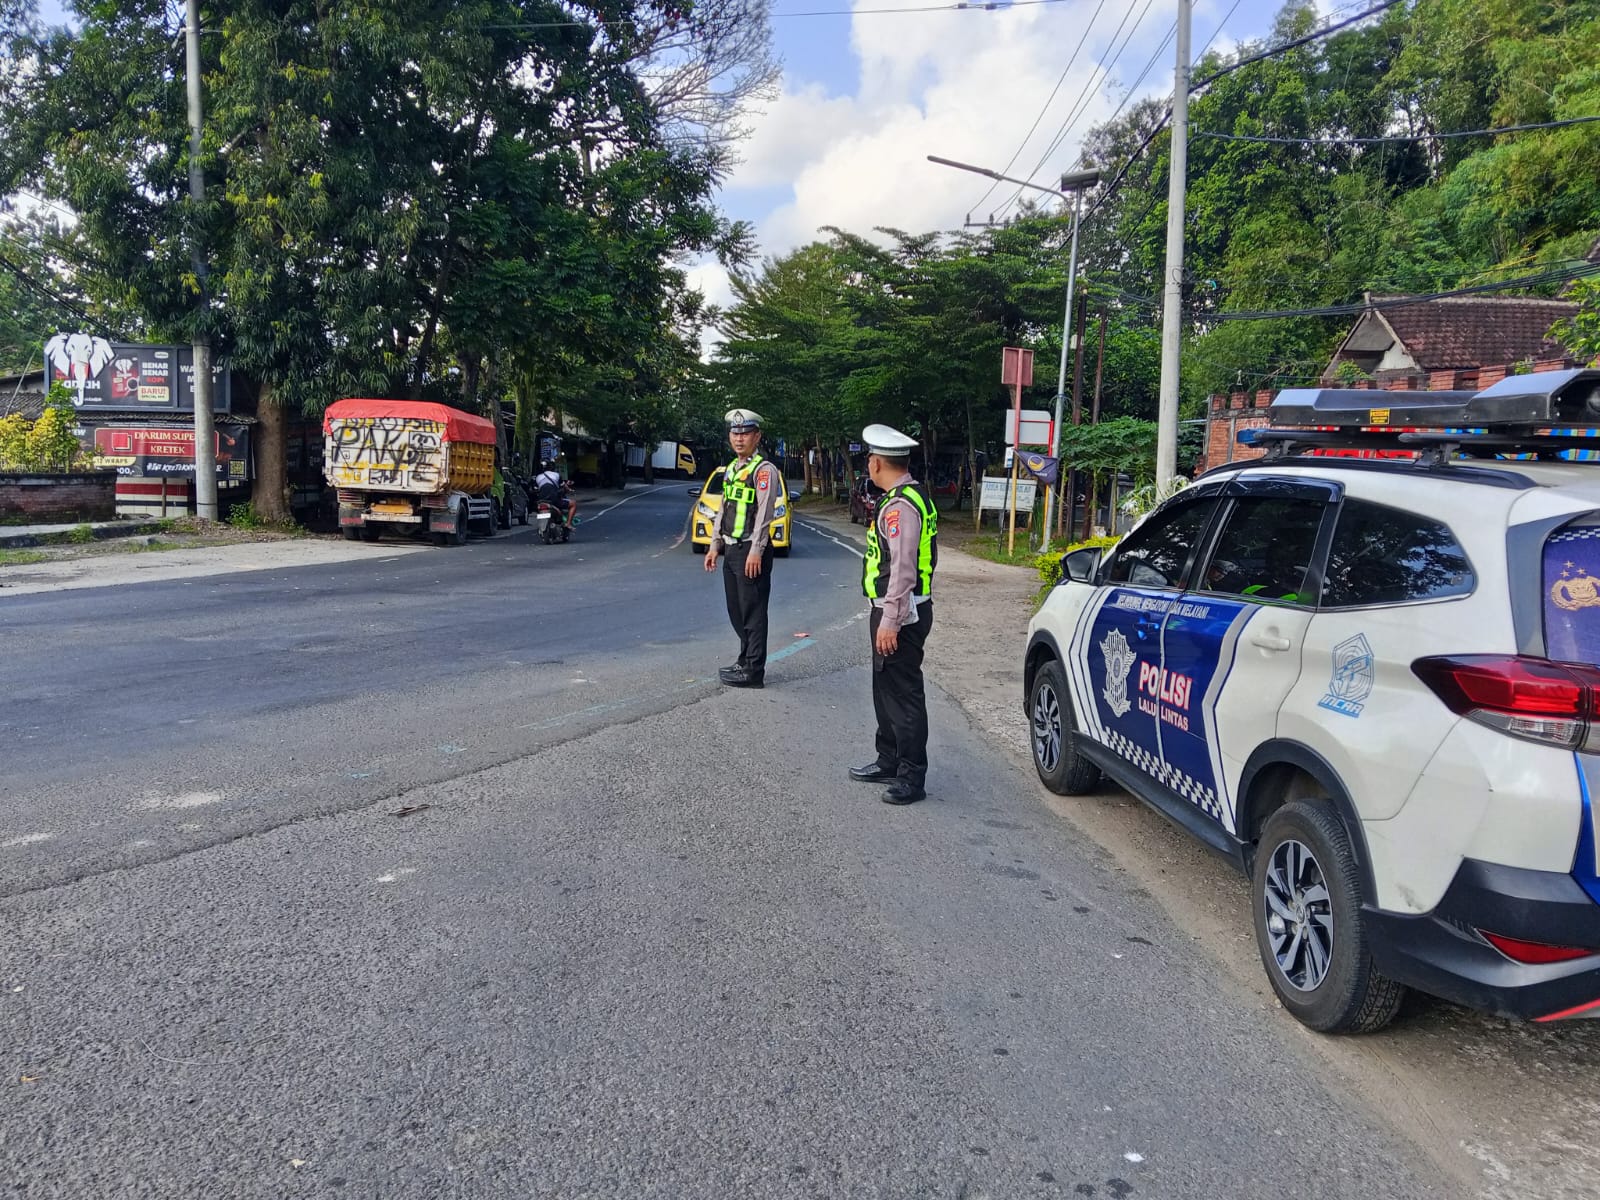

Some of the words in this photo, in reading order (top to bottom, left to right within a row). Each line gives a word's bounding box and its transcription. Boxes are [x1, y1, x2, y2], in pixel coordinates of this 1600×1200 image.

[142, 369, 168, 377] BENAR
[134, 431, 171, 440] DJARUM
[172, 432, 197, 440] SUPE
[151, 445, 185, 454] KRETEK
[1138, 660, 1193, 711] POLISI
[1138, 697, 1157, 717] LALU
[1160, 706, 1189, 732] LINTAS
